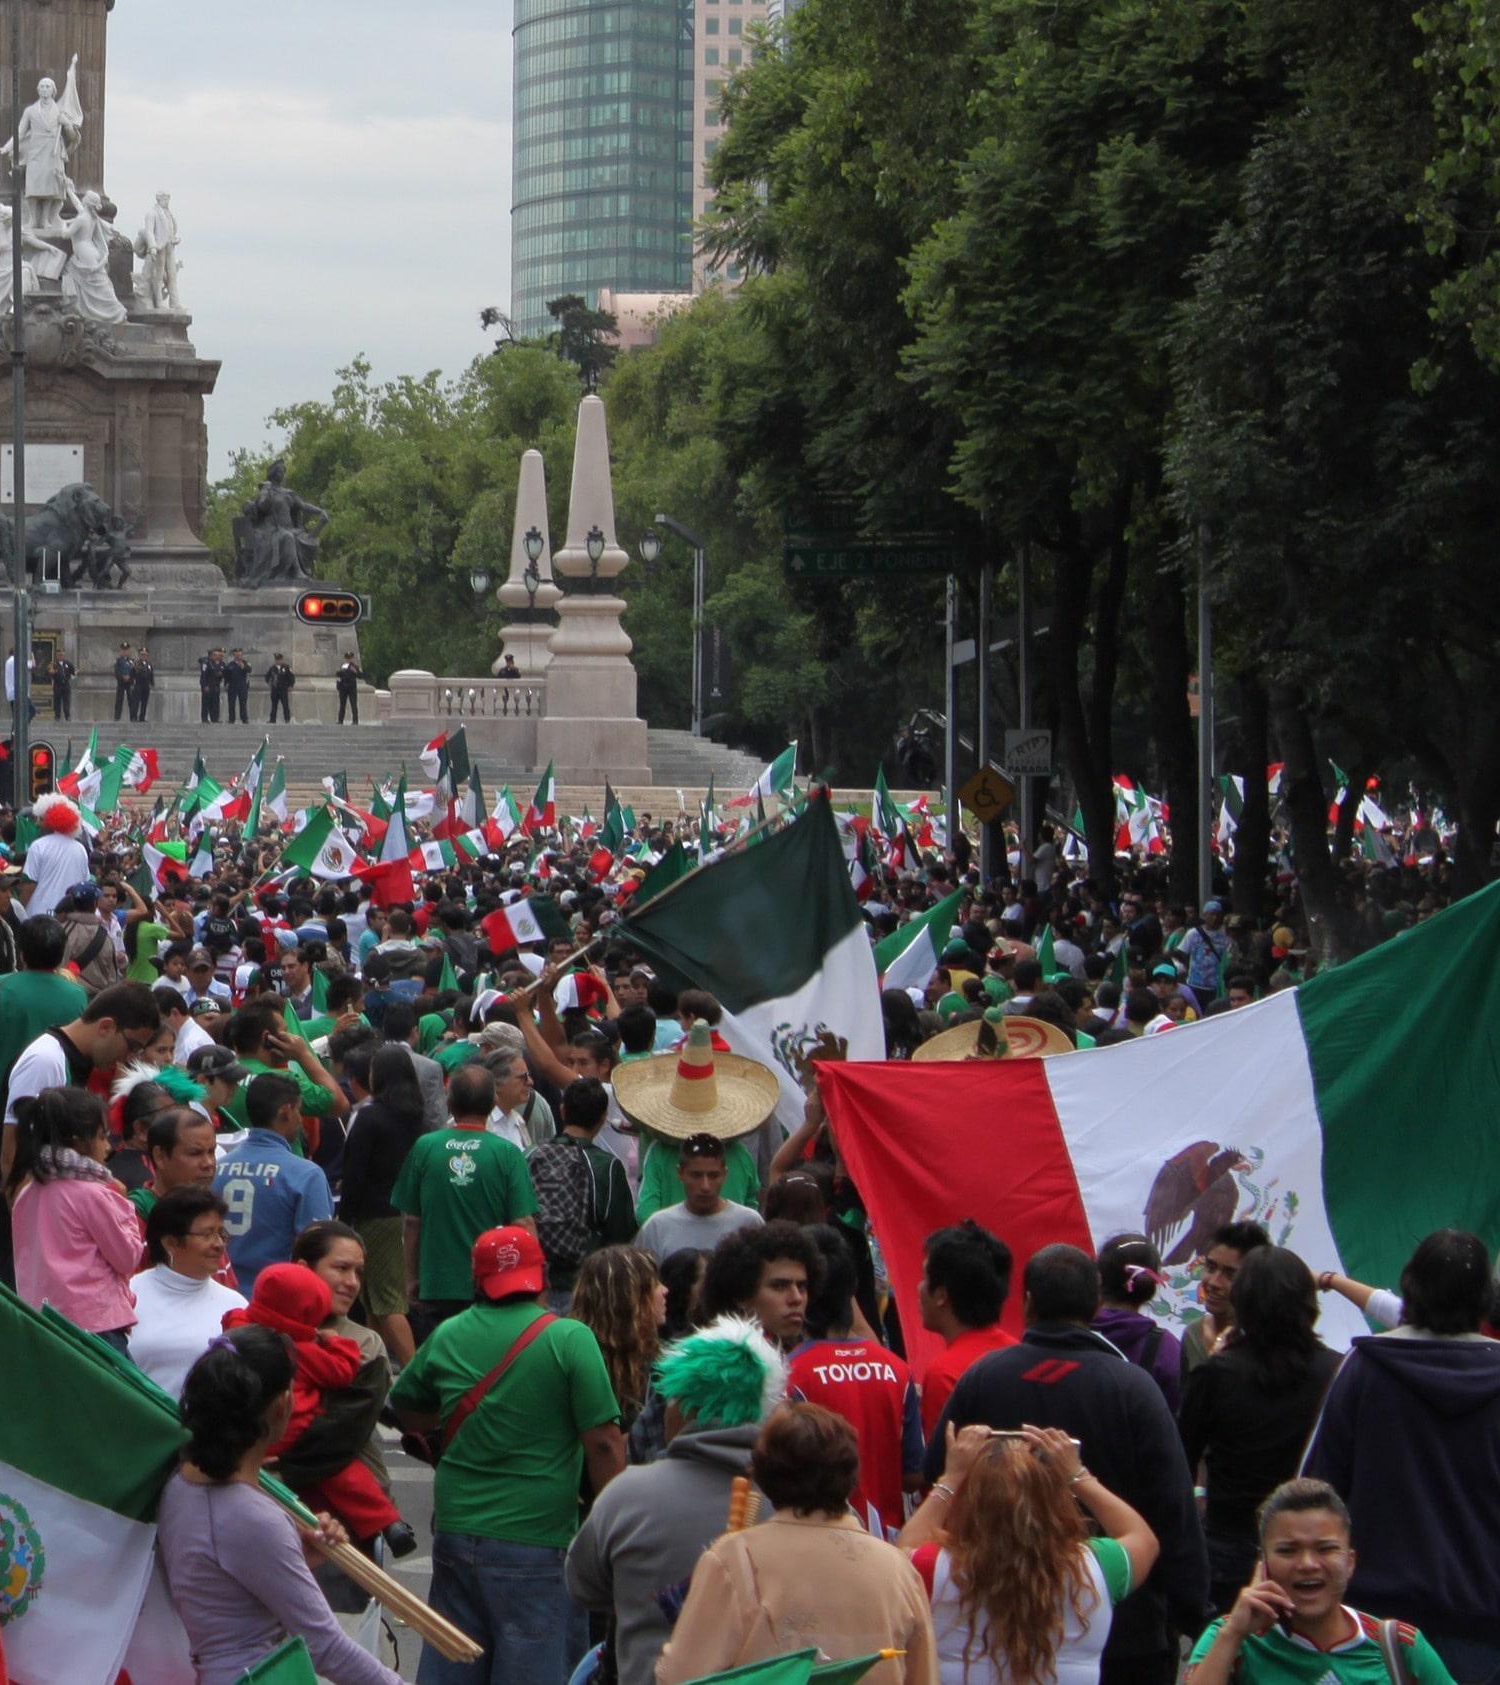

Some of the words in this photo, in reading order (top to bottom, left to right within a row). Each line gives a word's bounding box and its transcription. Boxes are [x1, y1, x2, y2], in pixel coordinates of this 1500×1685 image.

[816, 552, 848, 570] EJE
[857, 552, 867, 570] 2
[1007, 765, 1049, 774] PARADA
[222, 1178, 255, 1237] 9
[812, 1361, 898, 1385] TOYOTA
